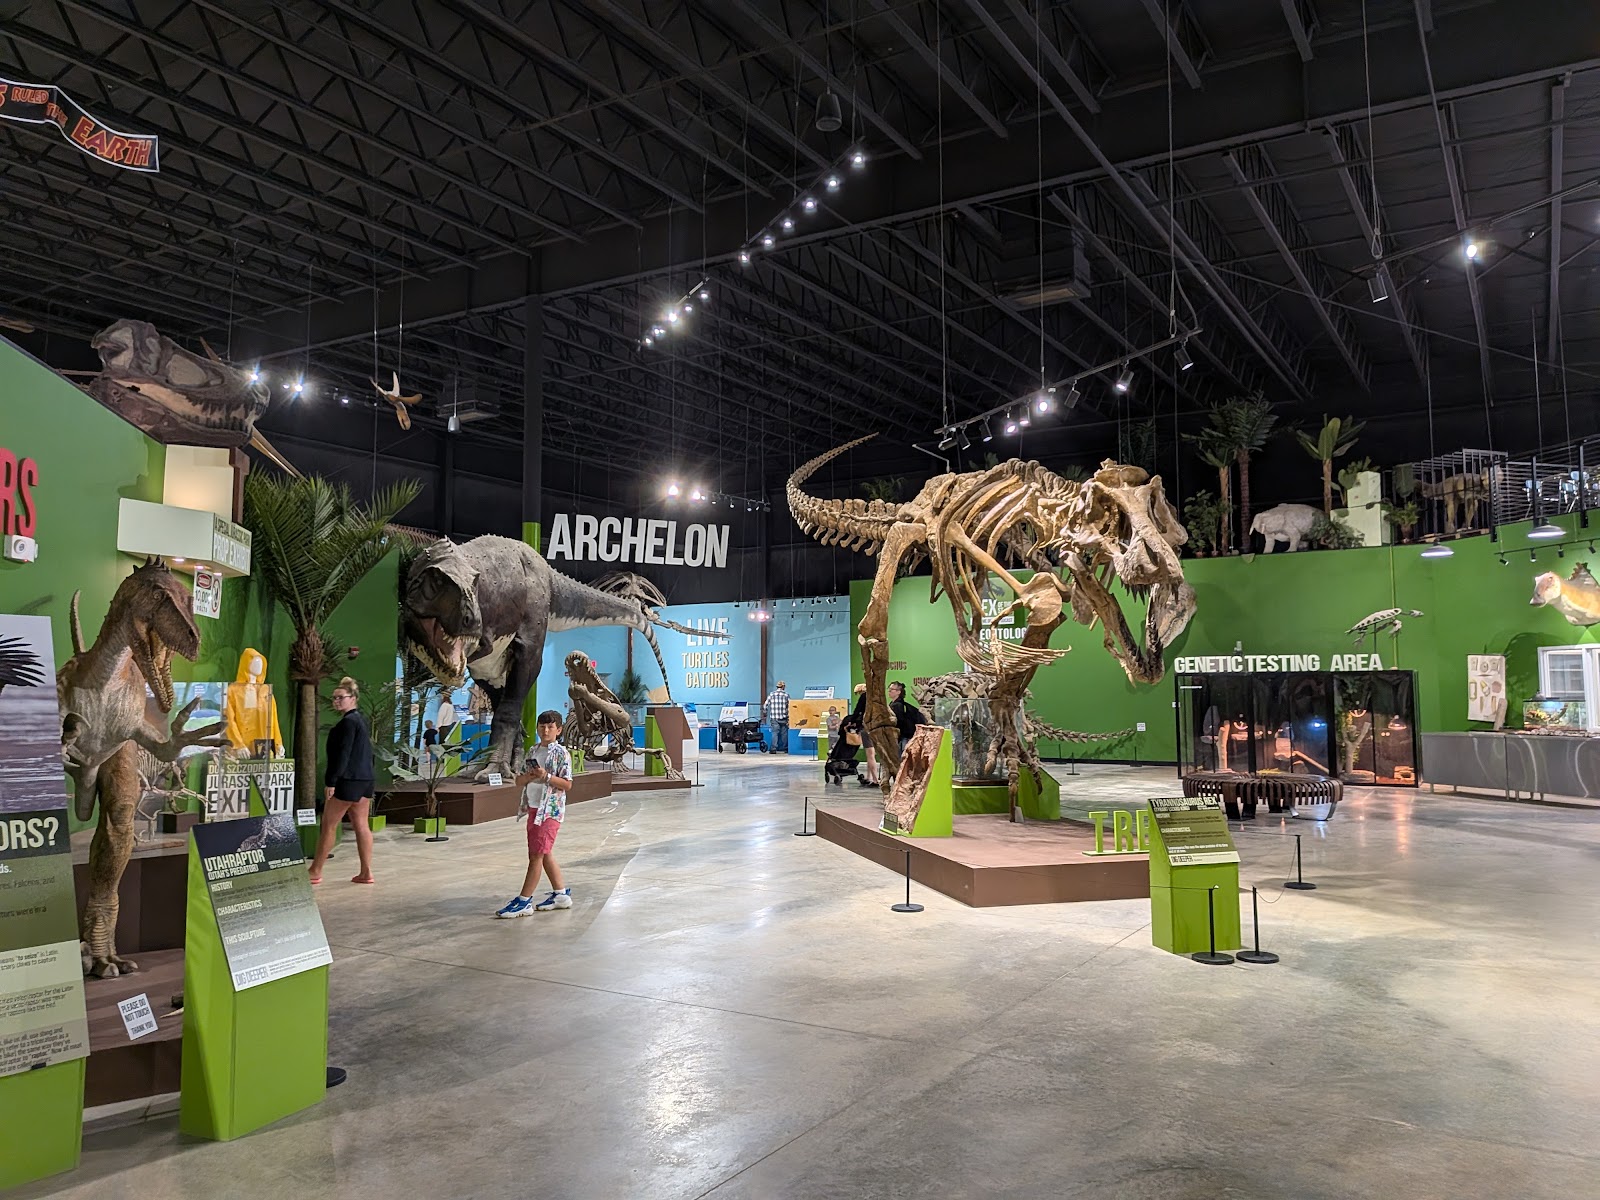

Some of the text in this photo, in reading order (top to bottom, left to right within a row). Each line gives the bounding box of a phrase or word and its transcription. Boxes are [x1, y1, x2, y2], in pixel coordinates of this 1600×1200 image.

[11, 87, 49, 104] RULED
[71, 116, 152, 166] EARTH
[547, 513, 730, 568] ARCHELON
[686, 617, 730, 647] LIVE
[681, 651, 729, 669] TURTLES
[1174, 653, 1383, 673] GENETIC TESTING AREA
[686, 671, 729, 689] GATORS
[208, 787, 292, 814] EXHBIT
[1151, 798, 1204, 808] TYRANNOSAURUS
[1205, 797, 1217, 805] REX
[204, 849, 265, 871] UTAHRAPTOR
[211, 881, 233, 892] HISTORY
[217, 899, 263, 916] CHARACTERISTICS
[121, 997, 147, 1014] PLEASE DO
[124, 1006, 151, 1023] NOT TOUCH
[131, 1020, 154, 1035] THANK YOU
